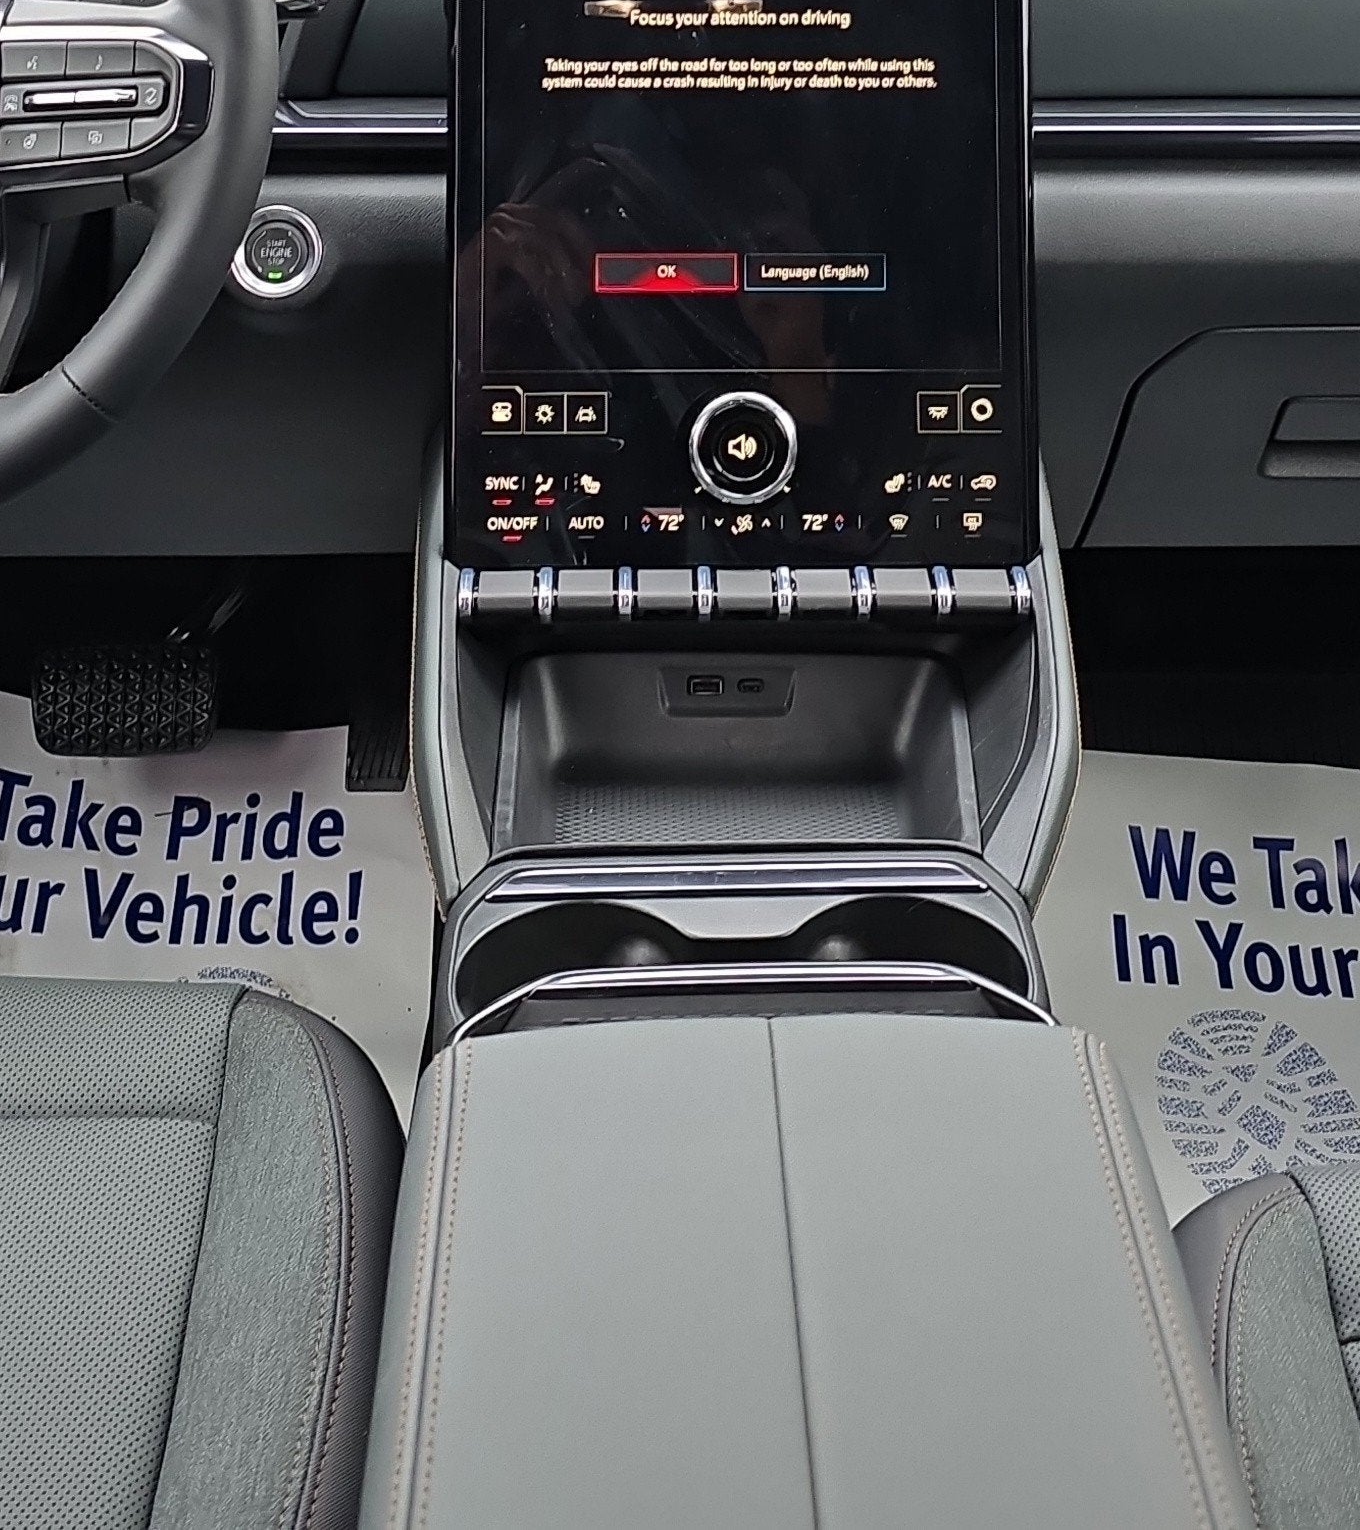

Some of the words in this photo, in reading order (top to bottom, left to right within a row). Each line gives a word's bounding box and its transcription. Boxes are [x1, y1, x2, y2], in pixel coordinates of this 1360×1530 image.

[630, 9, 674, 26] Focus
[676, 12, 708, 29] your
[711, 10, 776, 26] attention
[779, 12, 798, 26] on
[801, 9, 851, 29] driving
[545, 58, 582, 74] Taking
[584, 61, 610, 74] your
[612, 61, 638, 74] eyes
[640, 57, 658, 72] off
[659, 58, 679, 72] the
[681, 58, 708, 72] road
[709, 57, 727, 72] for
[728, 59, 748, 72] too
[750, 58, 776, 74] long
[778, 61, 791, 72] or
[793, 59, 813, 72] too
[815, 57, 846, 72] often
[847, 58, 878, 72] while
[880, 58, 911, 74] using
[913, 58, 935, 72] this
[542, 76, 582, 91] system
[584, 75, 616, 88] could
[617, 78, 652, 88] cause
[653, 78, 662, 88] a
[663, 75, 695, 88] crash
[696, 75, 746, 91] resulting
[747, 76, 759, 88] in
[760, 76, 792, 91] injury
[793, 78, 808, 88] or
[808, 75, 842, 88] death
[843, 76, 857, 88] to
[857, 78, 881, 91] you
[881, 78, 895, 88] or
[896, 75, 937, 88] others.
[260, 247, 293, 258] ENGINE
[657, 265, 677, 279] OK
[761, 265, 817, 281] Language
[819, 264, 869, 281] (English)
[485, 476, 520, 491] SYNC
[927, 474, 953, 489] A/C
[487, 516, 539, 531] ON/OFF
[568, 516, 605, 530] AUTO
[165, 791, 344, 862] Pride
[1129, 825, 1237, 906] We
[84, 867, 363, 946] Vehicle!
[1113, 914, 1179, 986] In
[1195, 919, 1359, 999] Your
